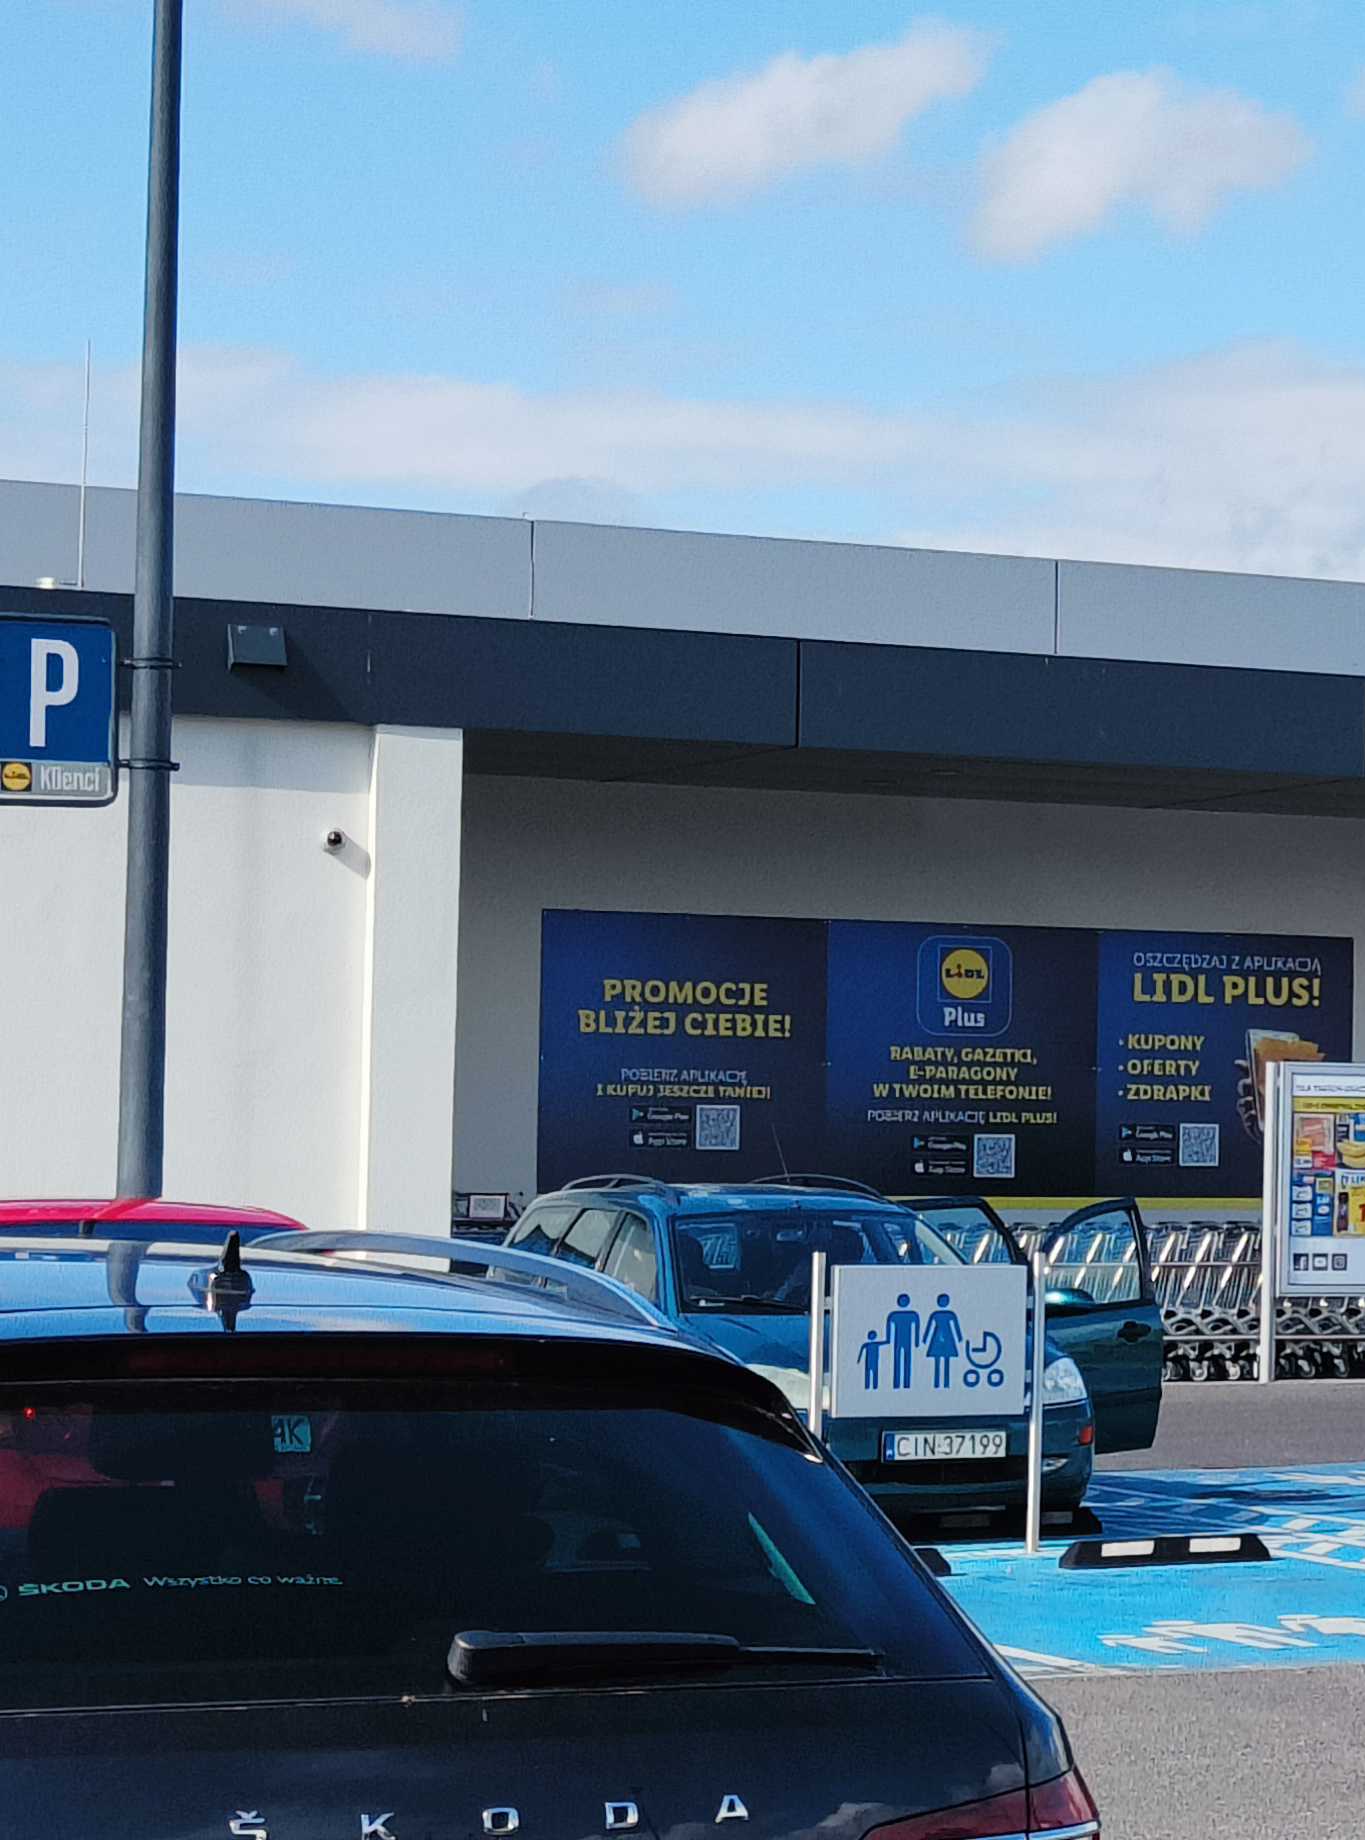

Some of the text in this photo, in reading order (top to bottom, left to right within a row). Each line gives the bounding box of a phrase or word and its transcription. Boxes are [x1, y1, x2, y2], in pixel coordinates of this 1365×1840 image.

[29, 638, 80, 747] P
[40, 764, 99, 792] Klienci
[1132, 952, 1321, 975] OSZCZĘDZAJ Z APLIKACJĄ
[603, 979, 769, 1006] PROMOCJE
[1132, 972, 1320, 1007] LIDL PLUS!
[577, 1005, 792, 1037] BLIŻEJ CIEBIE!
[943, 1006, 985, 1027] Plus
[1127, 1033, 1205, 1051] KUPONY
[890, 1046, 958, 1063] RABATY,
[909, 1065, 1018, 1081] E-PARAGONY
[1126, 1059, 1200, 1076] OFERTY
[606, 1084, 654, 1097] KUPUJ
[873, 1083, 1052, 1100] W TWOIM TELEFONIE!
[1126, 1084, 1212, 1102] ZDRAPKI
[988, 1111, 1018, 1123] LIDL
[897, 1434, 1003, 1457] CIN 37199
[17, 1577, 131, 1597] ŠKODA
[143, 1575, 243, 1590] Wszystko
[247, 1576, 272, 1586] co
